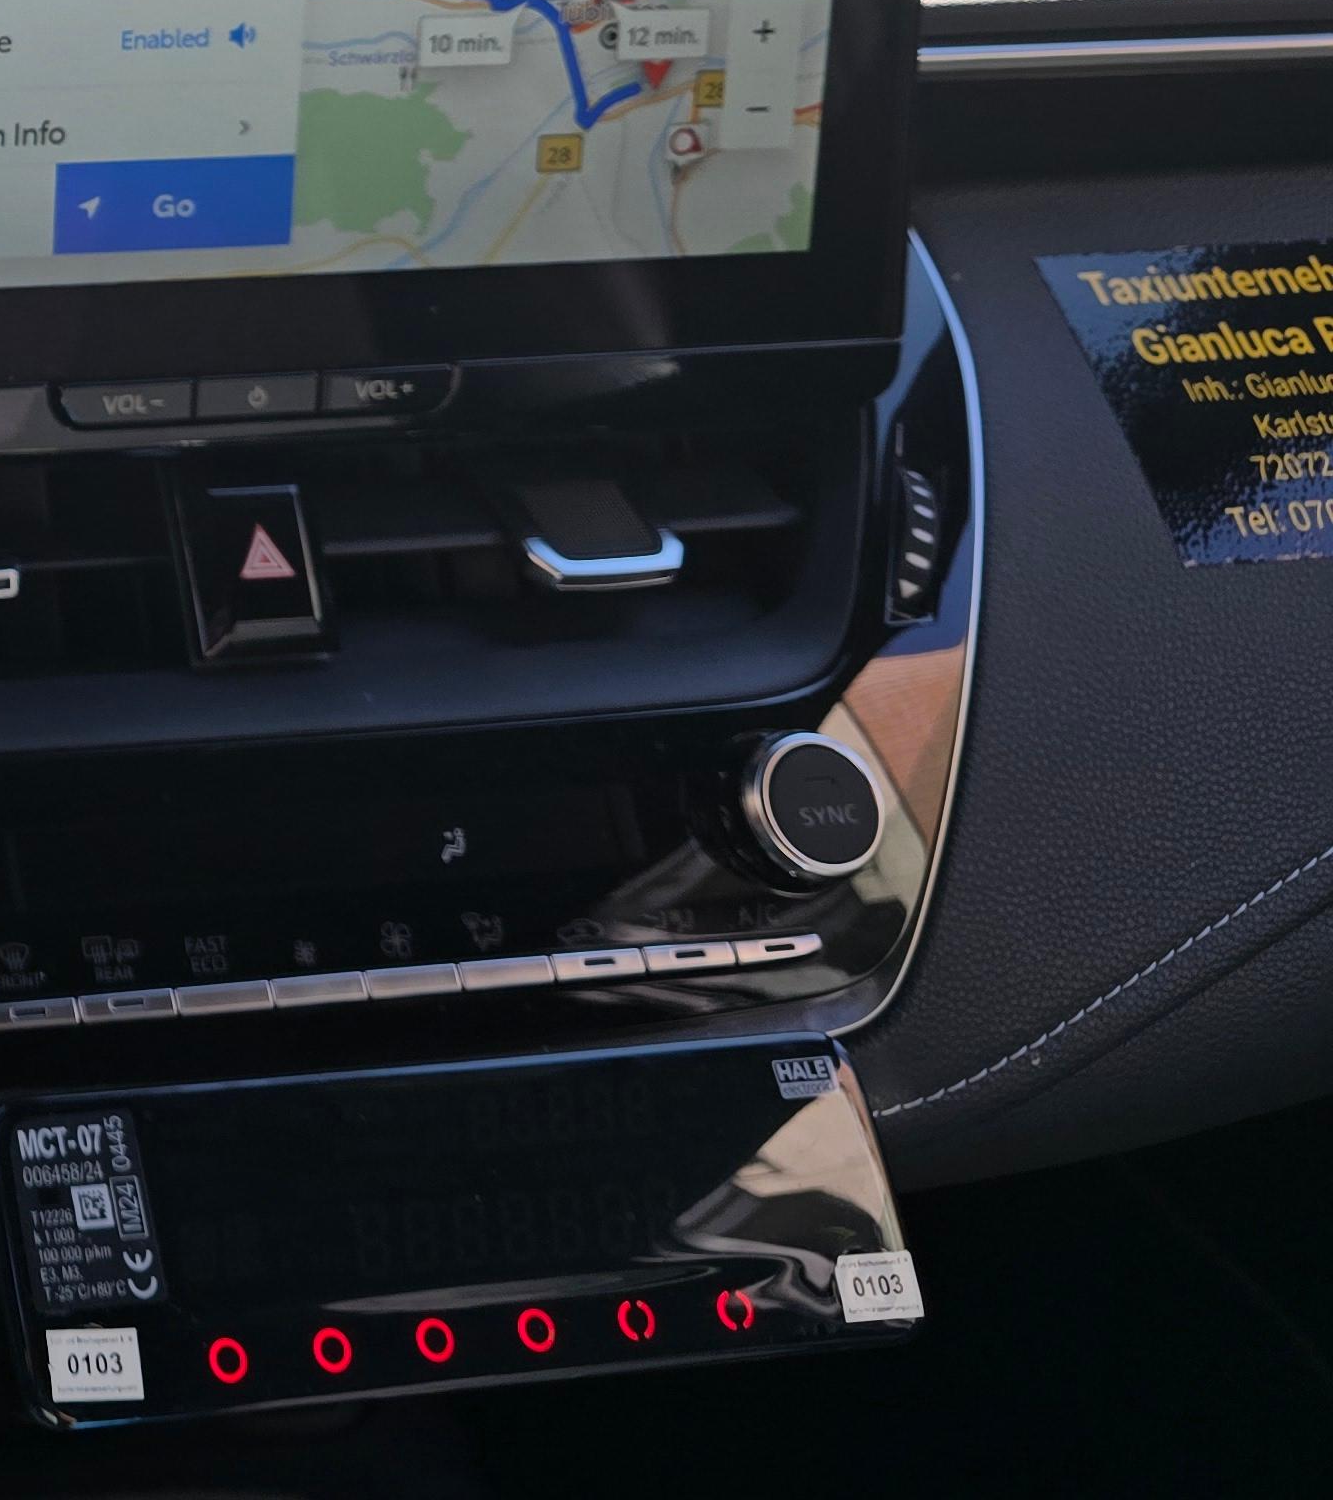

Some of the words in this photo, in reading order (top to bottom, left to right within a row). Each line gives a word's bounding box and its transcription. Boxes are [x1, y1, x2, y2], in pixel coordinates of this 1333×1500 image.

[120, 26, 211, 52] Enabled
[428, 34, 454, 54] 10
[457, 33, 502, 53] min.
[626, 27, 650, 48] 12
[653, 26, 700, 47] min.
[13, 120, 67, 148] Info
[546, 146, 573, 164] 28
[152, 193, 197, 220] Go
[1132, 320, 1316, 366] Gianluca
[1249, 451, 1333, 483] 72072
[797, 803, 862, 829] SYNC
[184, 935, 228, 953] FAST
[191, 953, 228, 973] ECO
[775, 1058, 829, 1082] HALE
[16, 1123, 103, 1162] MCT-07
[102, 1114, 132, 1173] 0445
[852, 1273, 904, 1298] 0103
[67, 1352, 123, 1375] 0103
